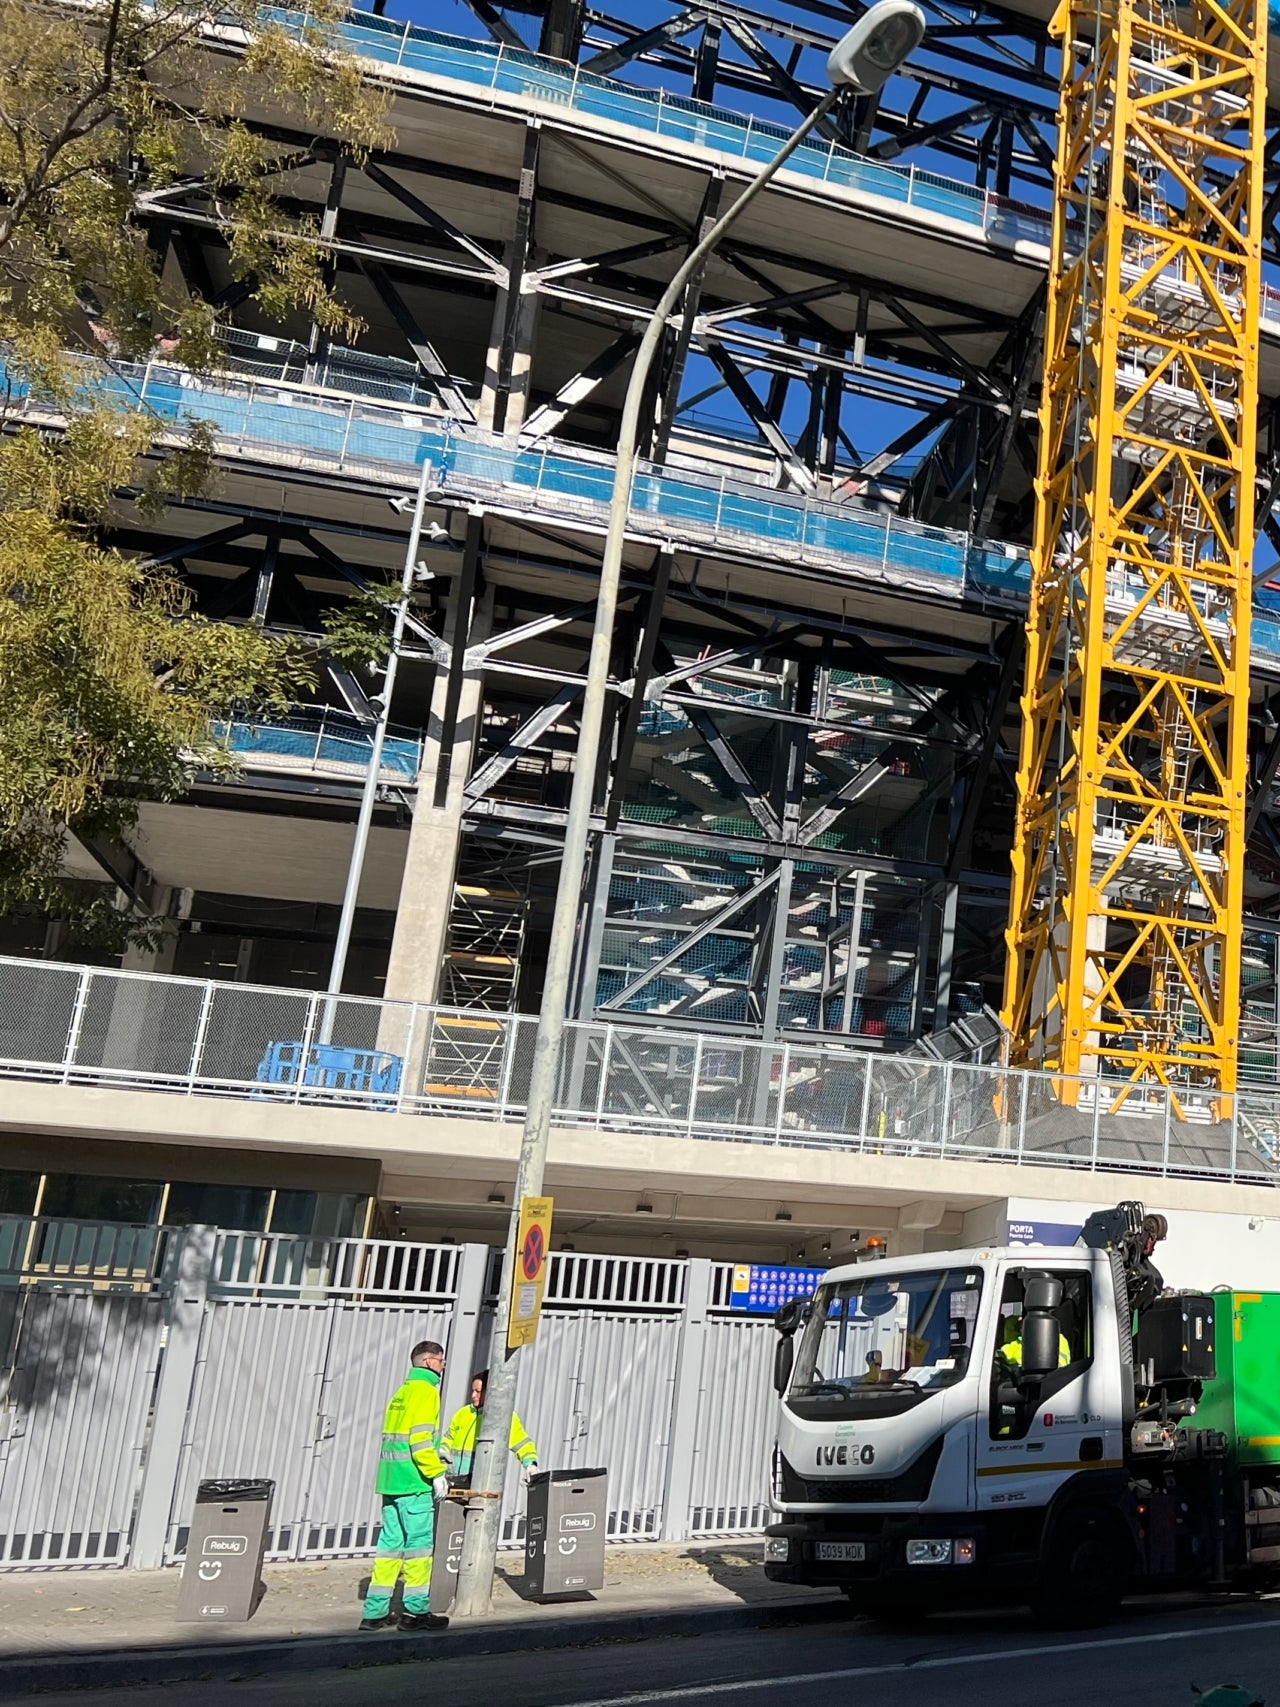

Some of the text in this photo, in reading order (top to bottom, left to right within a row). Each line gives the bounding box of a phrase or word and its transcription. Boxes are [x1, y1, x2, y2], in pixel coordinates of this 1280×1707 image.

[1009, 1224, 1034, 1234] PORTA
[816, 1444, 875, 1466] IVECO
[565, 1517, 590, 1527] Rebuig
[211, 1541, 240, 1551] Rebuig
[821, 1544, 863, 1559] 5039 MDK
